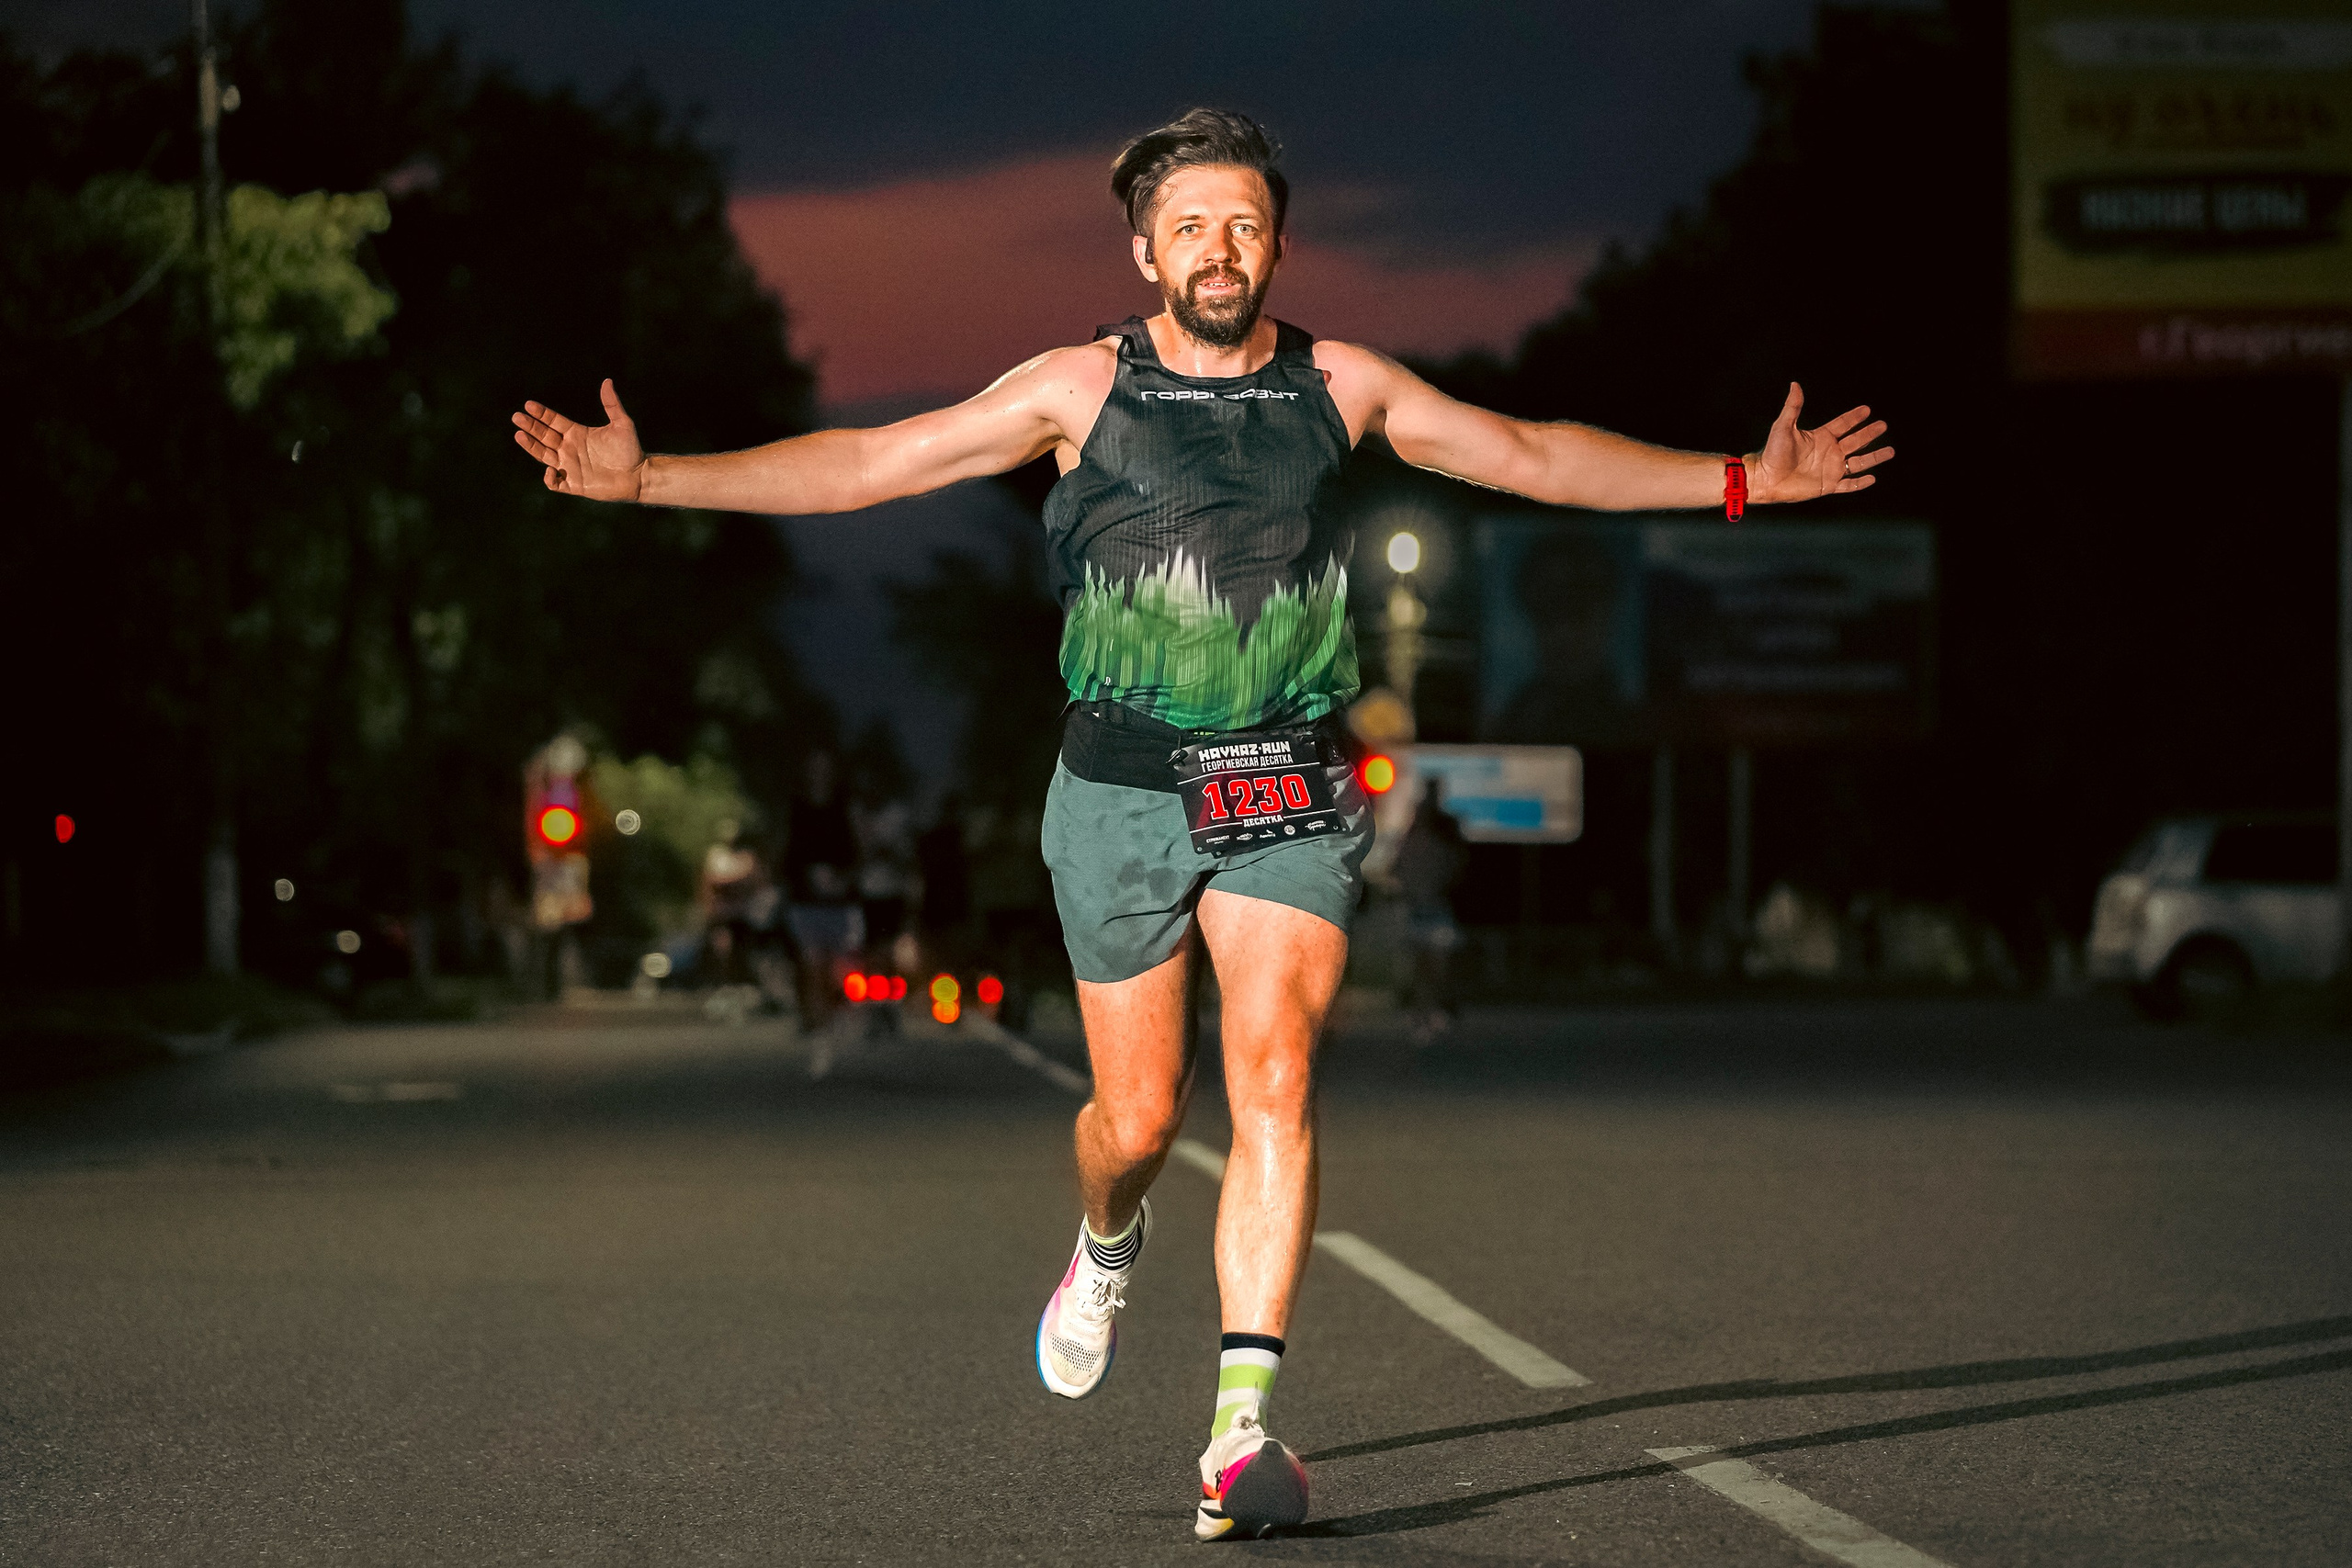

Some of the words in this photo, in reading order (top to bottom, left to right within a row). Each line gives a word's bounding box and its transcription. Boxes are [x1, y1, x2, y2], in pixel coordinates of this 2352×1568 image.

[1140, 389, 1215, 400] ГОРЫ
[1202, 757, 1260, 773] ГЕОРГИЕВСКАЯ
[1260, 753, 1294, 768] ДЕСЯТКА
[1202, 773, 1312, 820] 1230
[1243, 815, 1283, 827] ДЕСЯТКА
